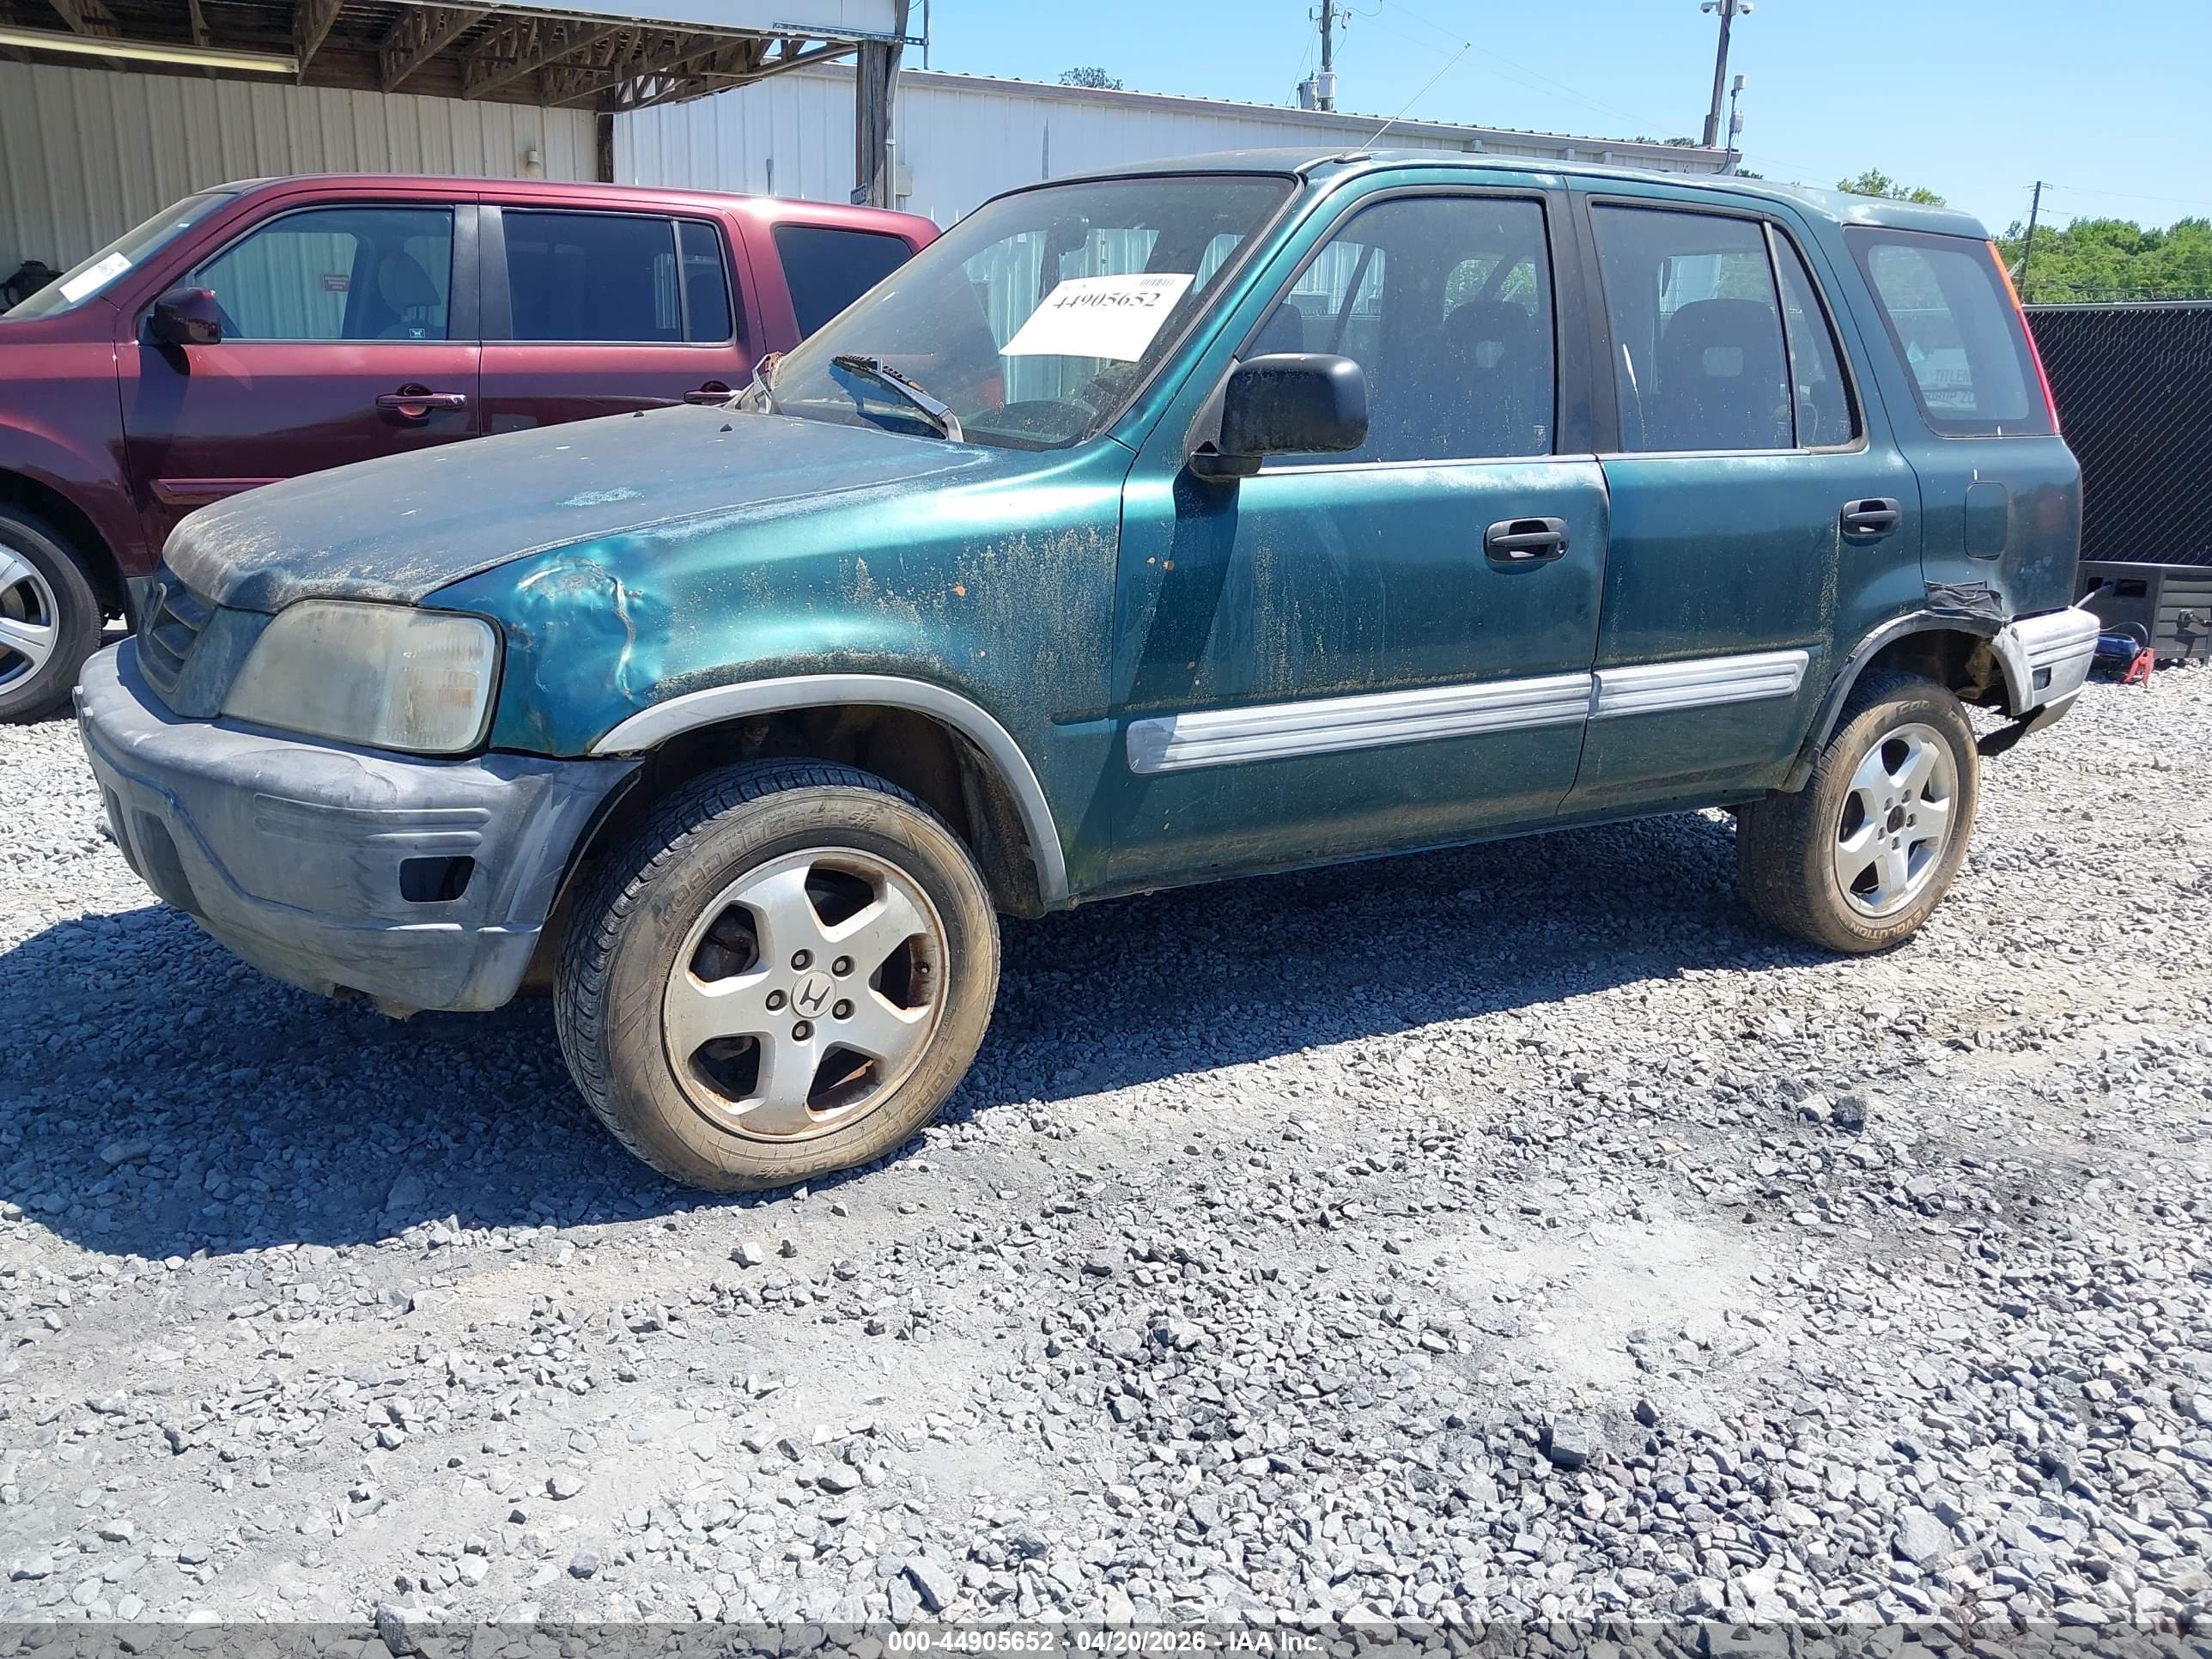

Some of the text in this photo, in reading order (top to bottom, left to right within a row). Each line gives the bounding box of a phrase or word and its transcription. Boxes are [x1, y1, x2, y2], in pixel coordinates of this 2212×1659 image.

[1053, 292, 1162, 309] 44905652
[659, 851, 724, 928] ROAD
[721, 809, 846, 859] HUGGER
[1849, 908, 1924, 940] EVOLUTION
